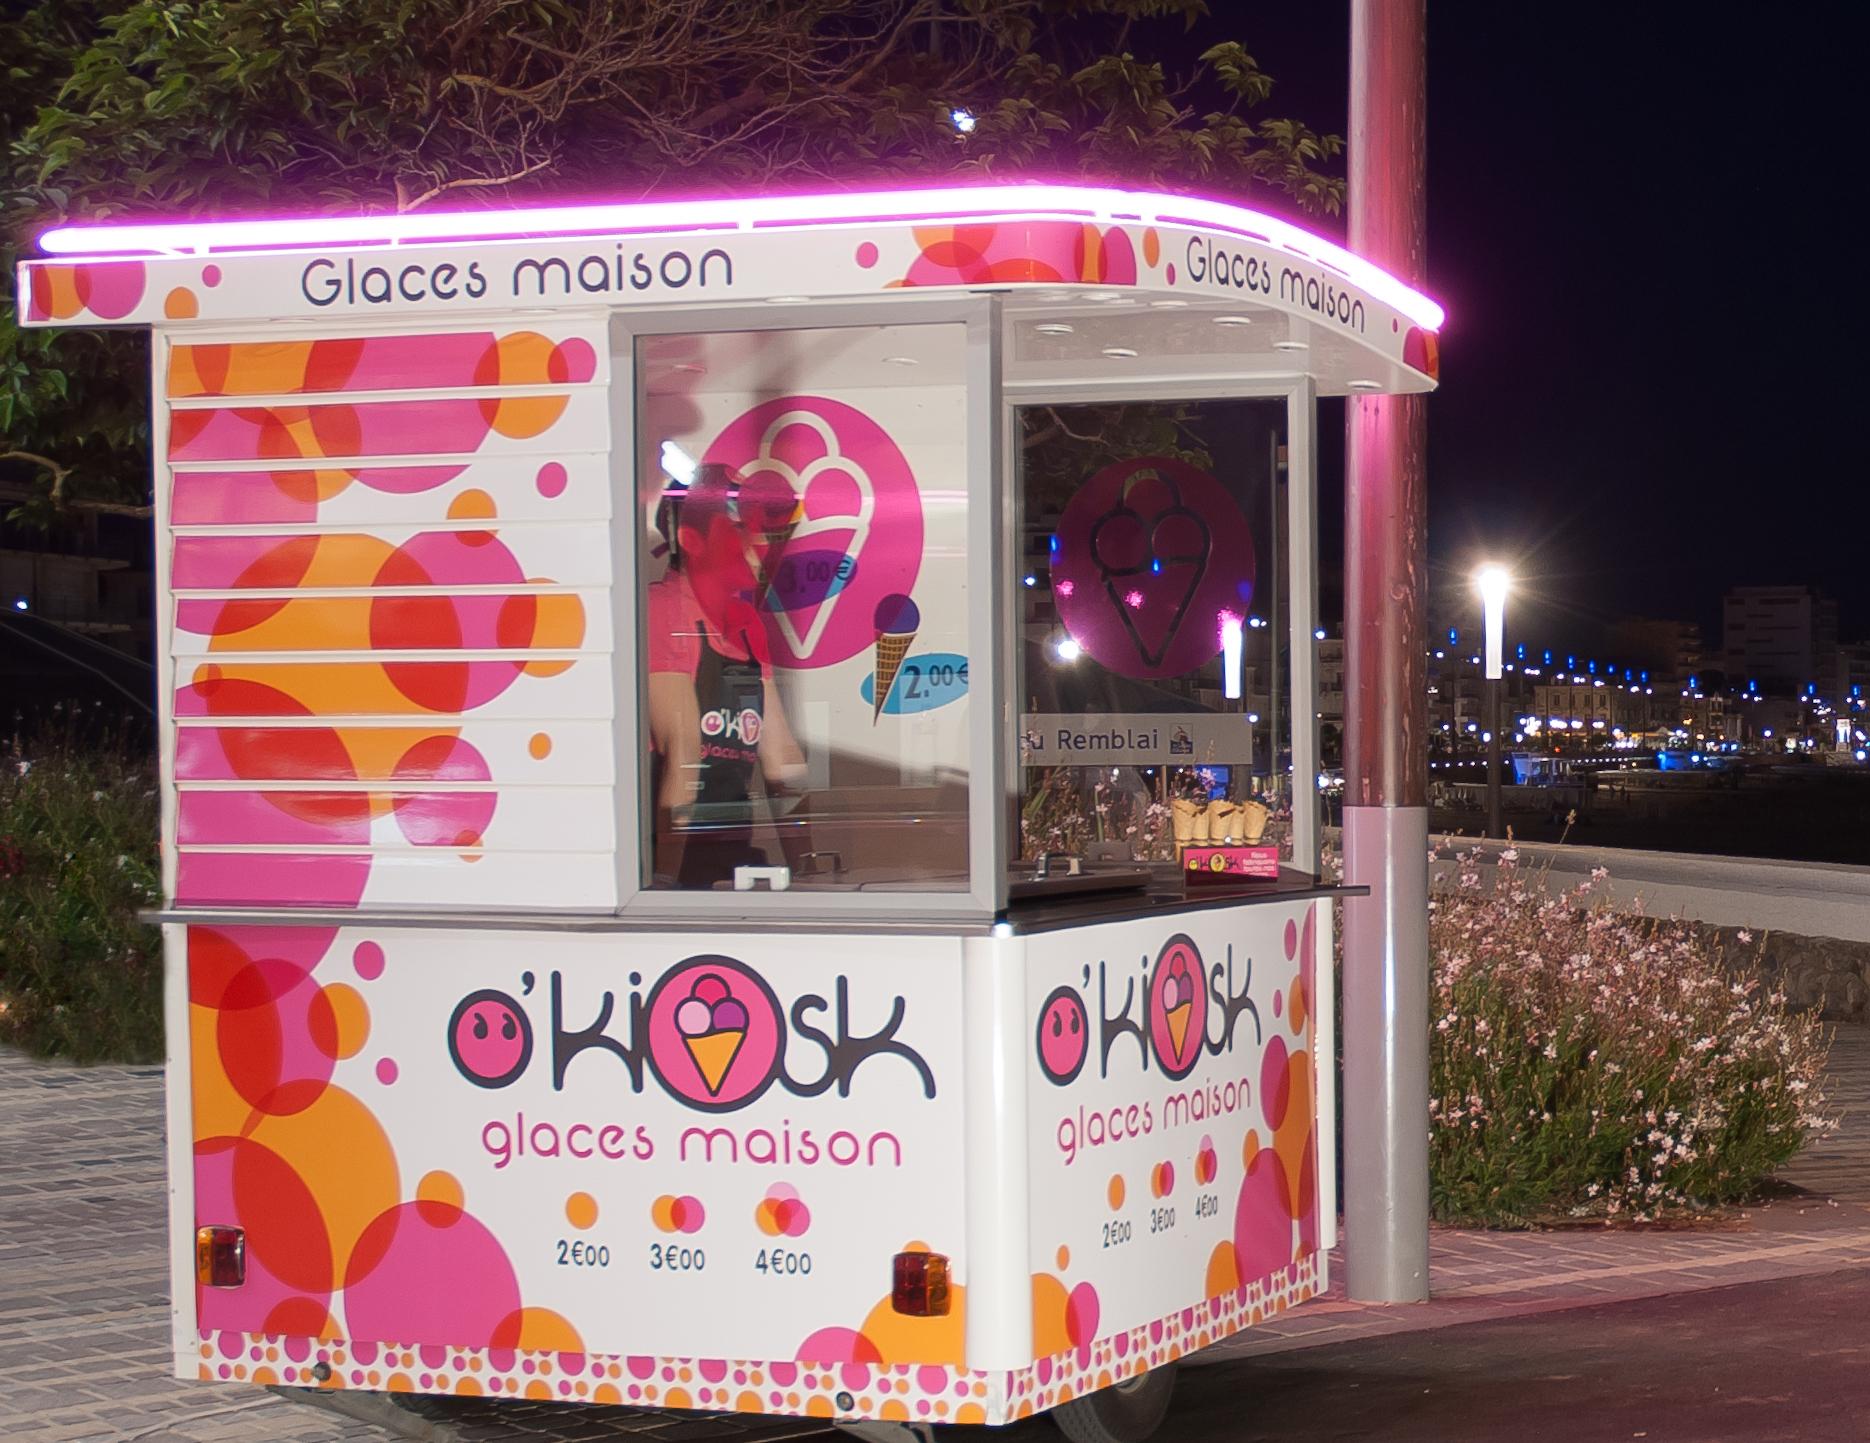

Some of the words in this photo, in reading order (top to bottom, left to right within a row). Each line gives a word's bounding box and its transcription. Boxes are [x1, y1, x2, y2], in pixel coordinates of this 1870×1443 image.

[302, 258, 487, 306] Glaces
[513, 243, 732, 296] maison
[1187, 236, 1270, 294] Glaces
[1280, 268, 1365, 333] maison
[1020, 734, 1044, 750] u
[1058, 729, 1157, 750] Remblai
[1057, 1101, 1153, 1166] glaces
[1163, 1078, 1251, 1130] maison
[481, 1112, 654, 1169] glaces
[680, 1120, 901, 1167] maison
[1150, 1207, 1175, 1234] 3€00
[1195, 1193, 1218, 1220] 4€00
[1102, 1219, 1132, 1248] 2€00
[556, 1239, 610, 1267] 2€00
[650, 1243, 705, 1270] 3€00
[755, 1248, 812, 1274] 4€00
